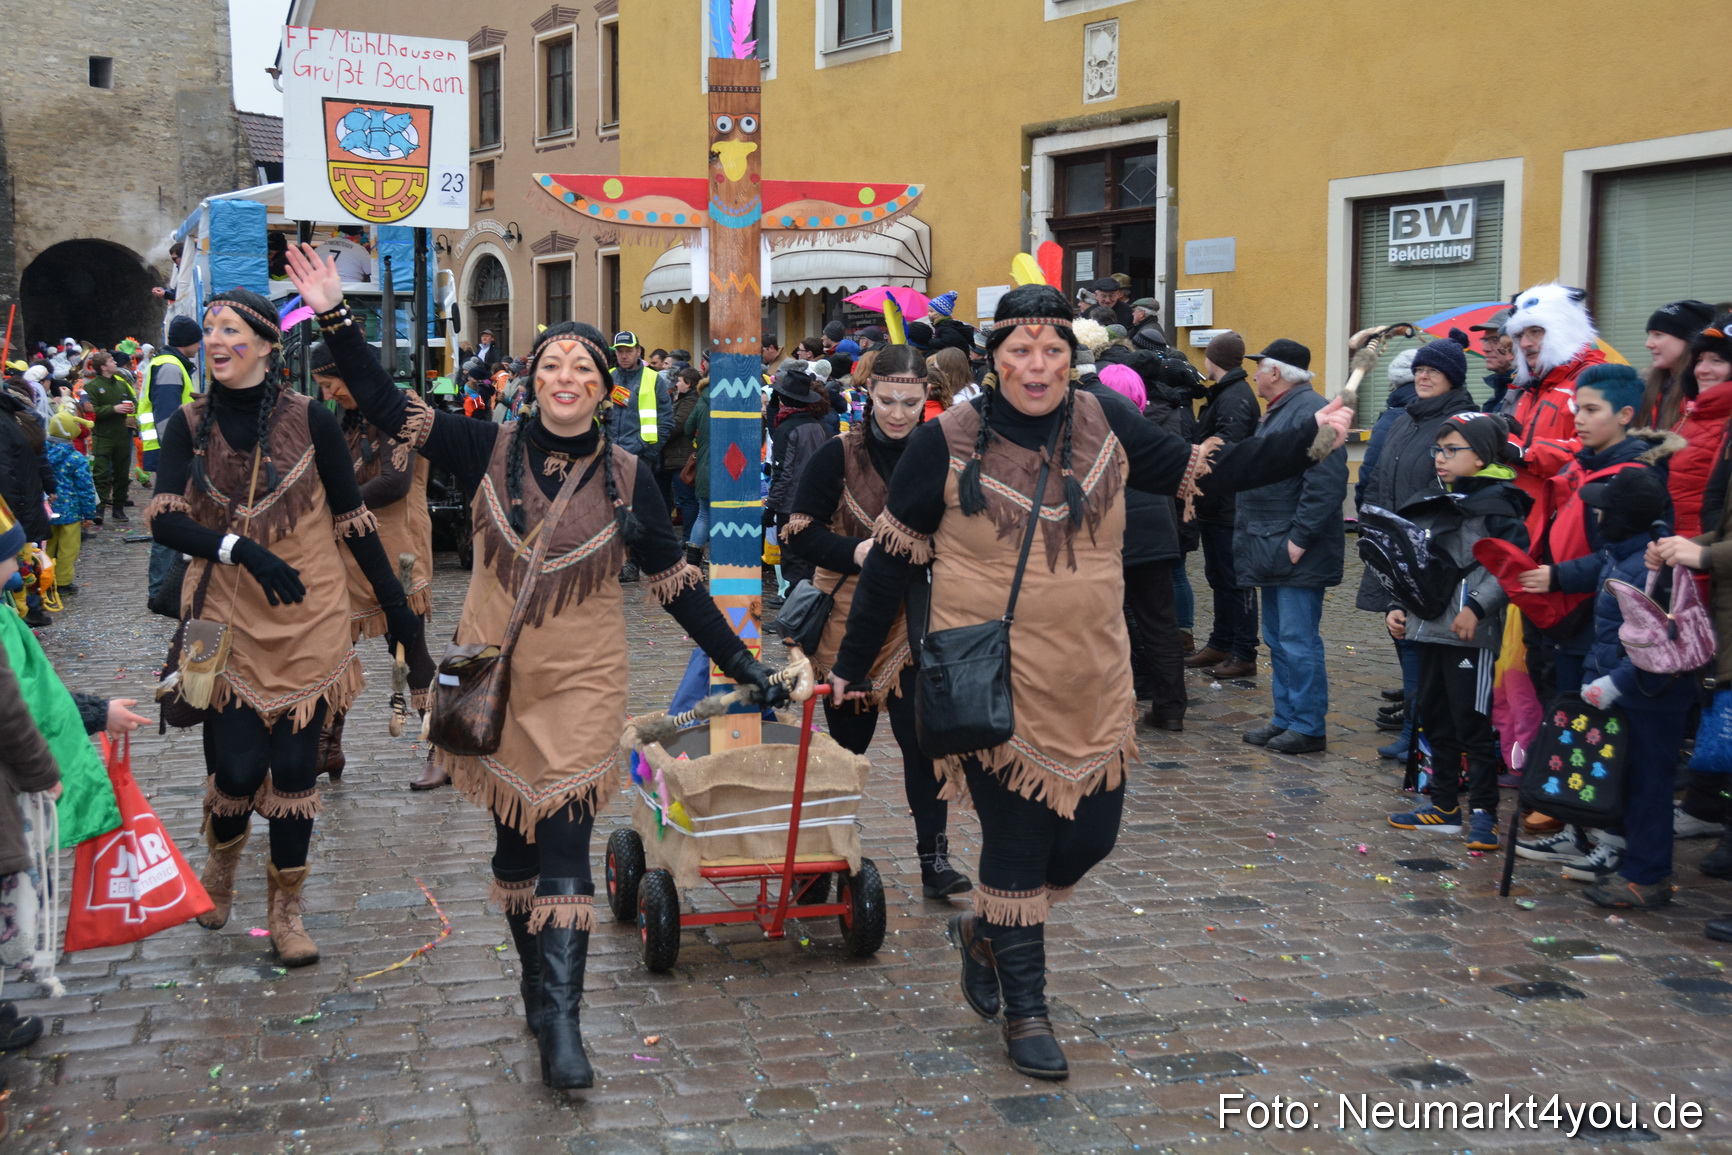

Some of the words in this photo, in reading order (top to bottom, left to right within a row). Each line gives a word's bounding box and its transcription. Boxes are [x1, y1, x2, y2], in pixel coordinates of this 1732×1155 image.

[330, 29, 457, 61] Mühlhausen
[293, 49, 364, 94] Grüßt
[375, 62, 465, 94] Bacham
[441, 172, 464, 193] 23
[1393, 203, 1469, 240] BW
[329, 249, 341, 262] 7
[1388, 244, 1471, 262] Bekleidung
